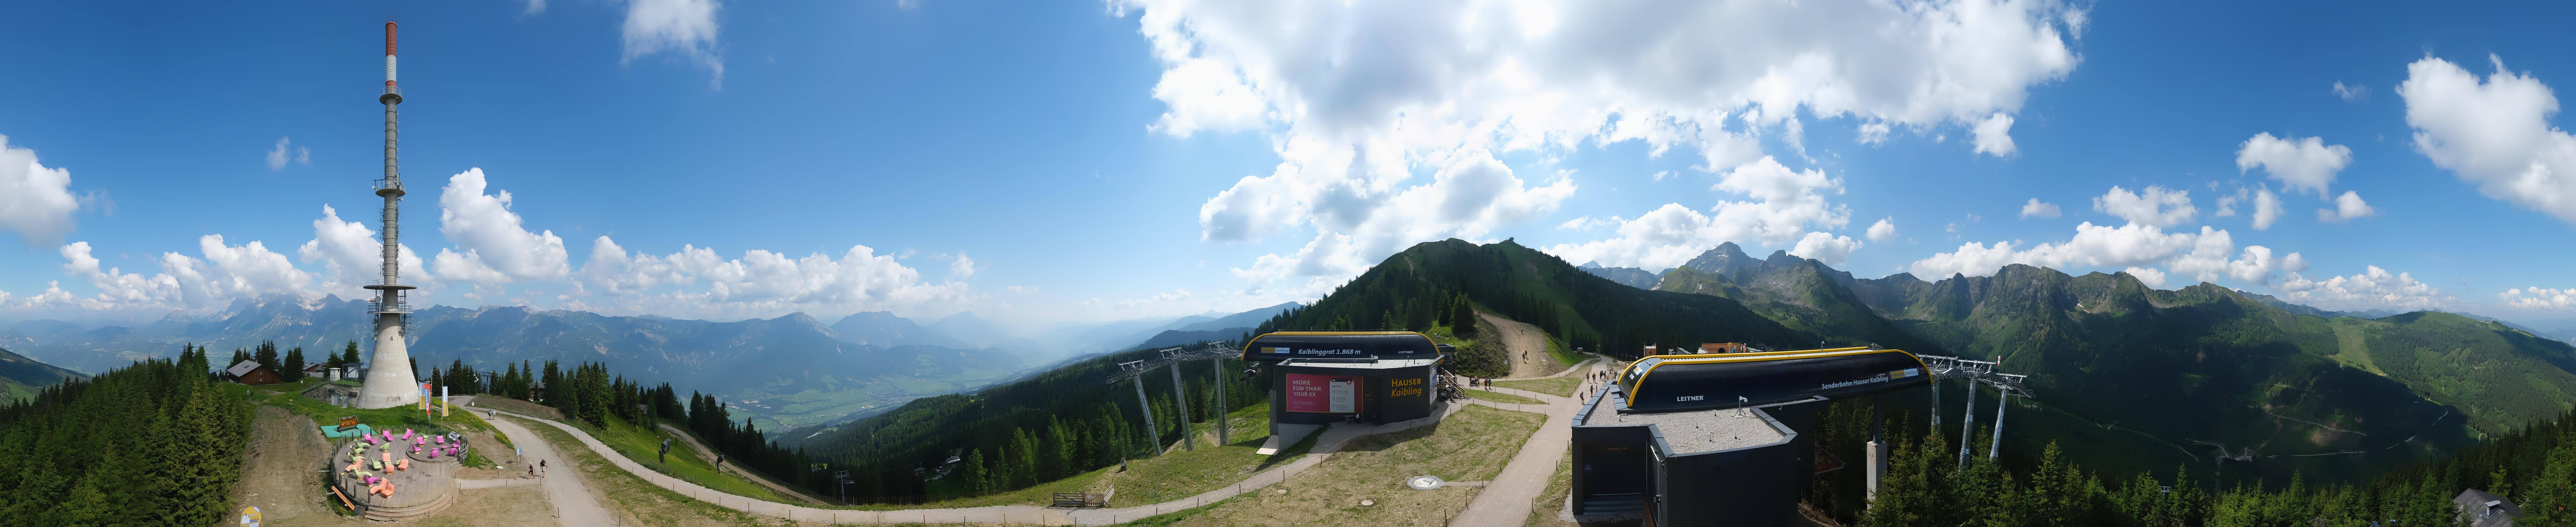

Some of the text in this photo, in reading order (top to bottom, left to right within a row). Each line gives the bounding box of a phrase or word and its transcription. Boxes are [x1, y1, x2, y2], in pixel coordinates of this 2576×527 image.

[1392, 378, 1421, 387] HAUSER
[1822, 381, 1852, 389] Senderbahn
[1391, 387, 1422, 397] Kaibling
